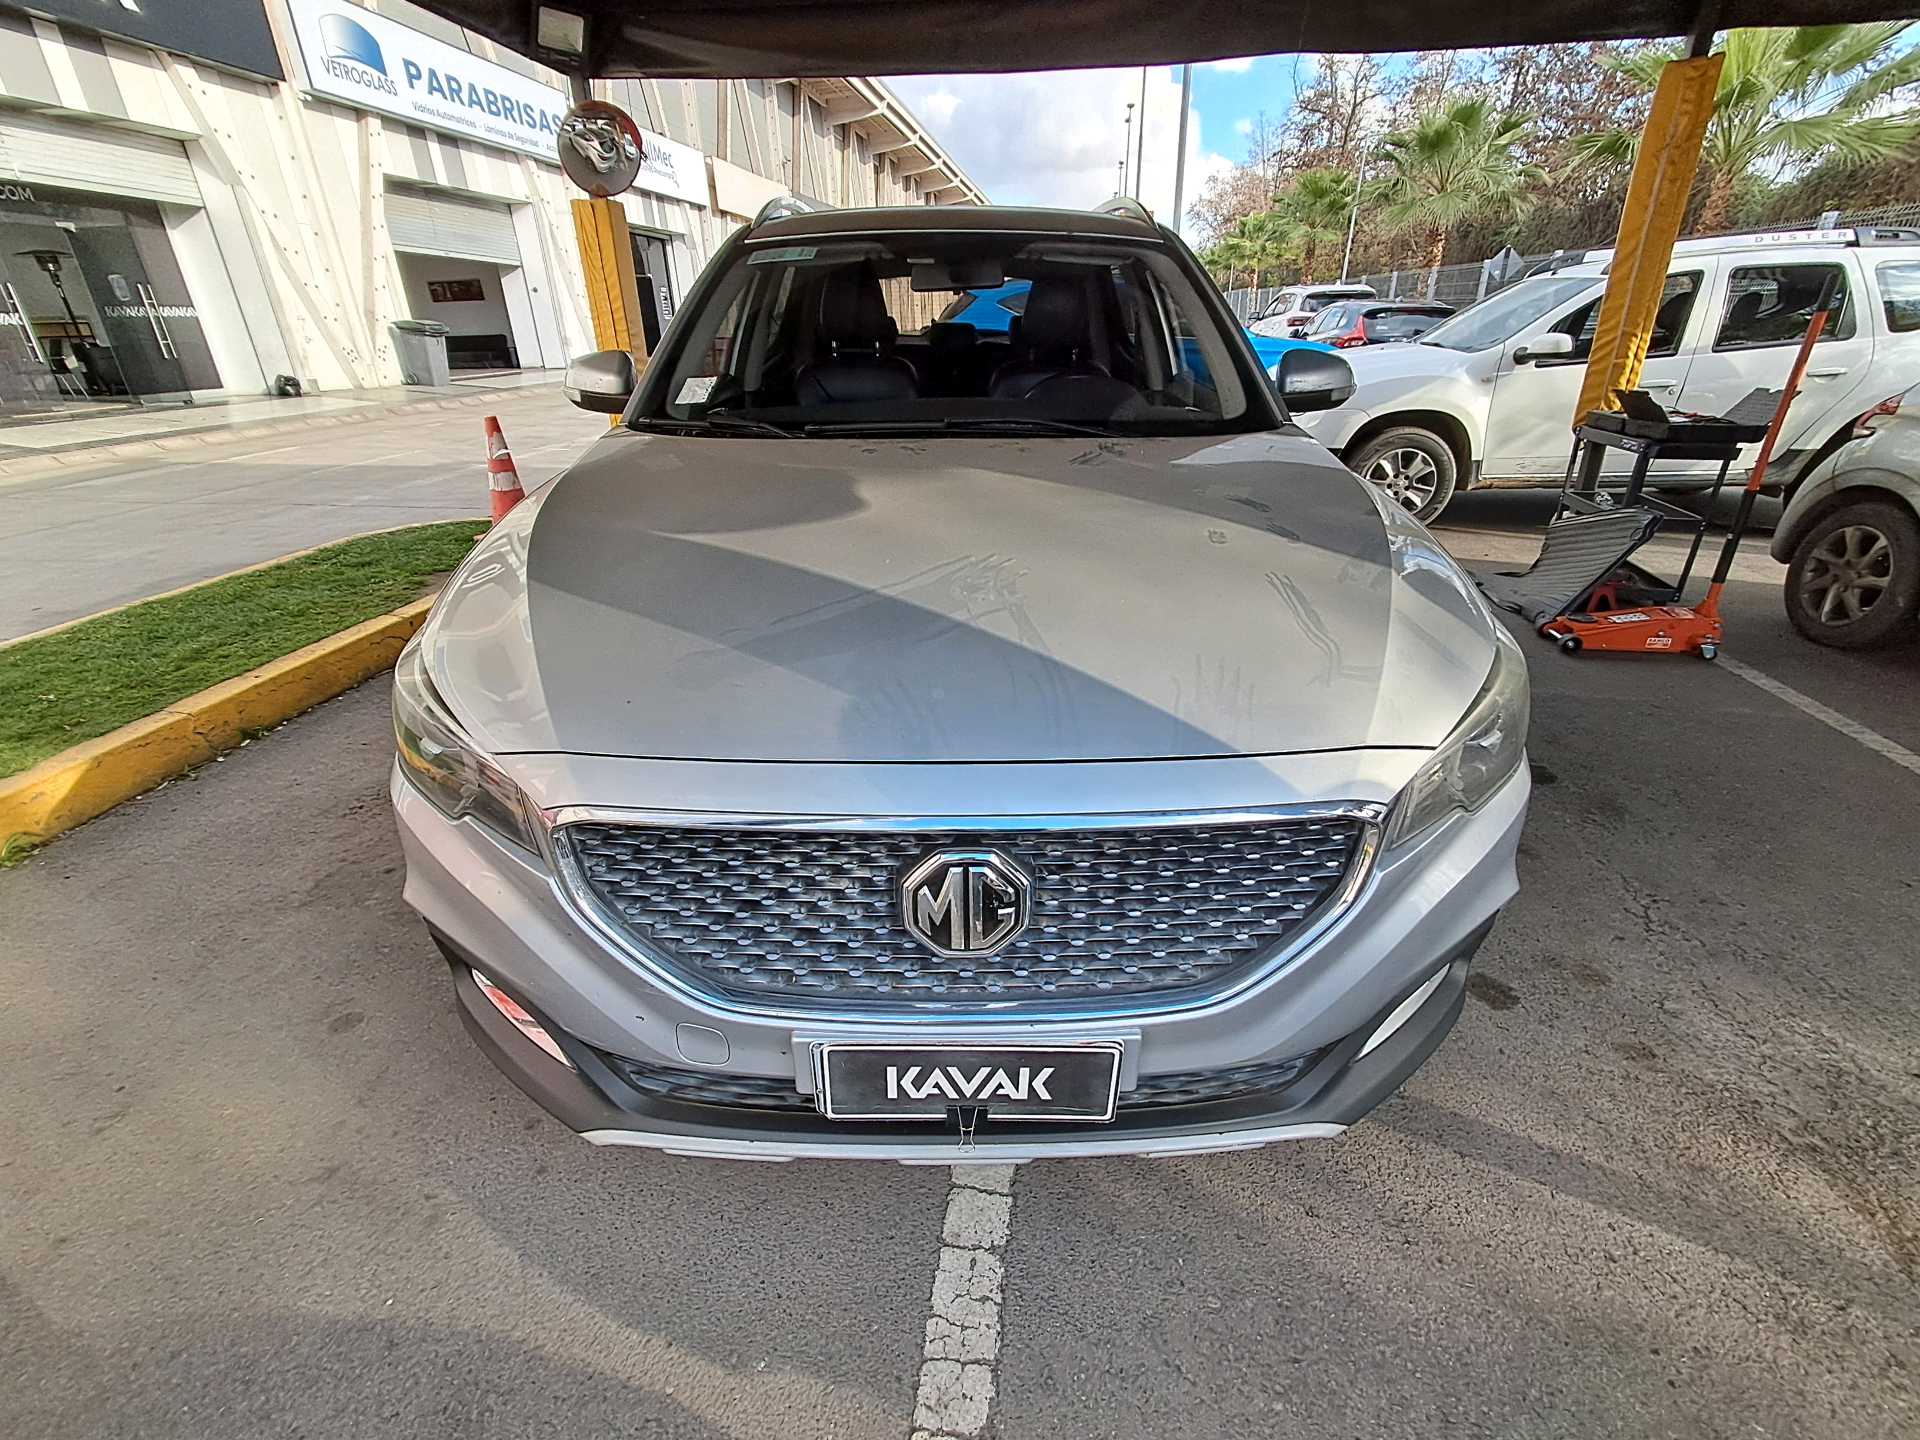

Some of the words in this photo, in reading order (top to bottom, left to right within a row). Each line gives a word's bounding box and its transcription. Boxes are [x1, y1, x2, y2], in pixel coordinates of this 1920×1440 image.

[320, 55, 398, 97] VETROGLASS
[402, 57, 563, 137] PARABRISAS
[1754, 231, 1848, 243] DUSTER
[917, 866, 1016, 951] MG
[886, 1066, 1057, 1101] KAVAK
